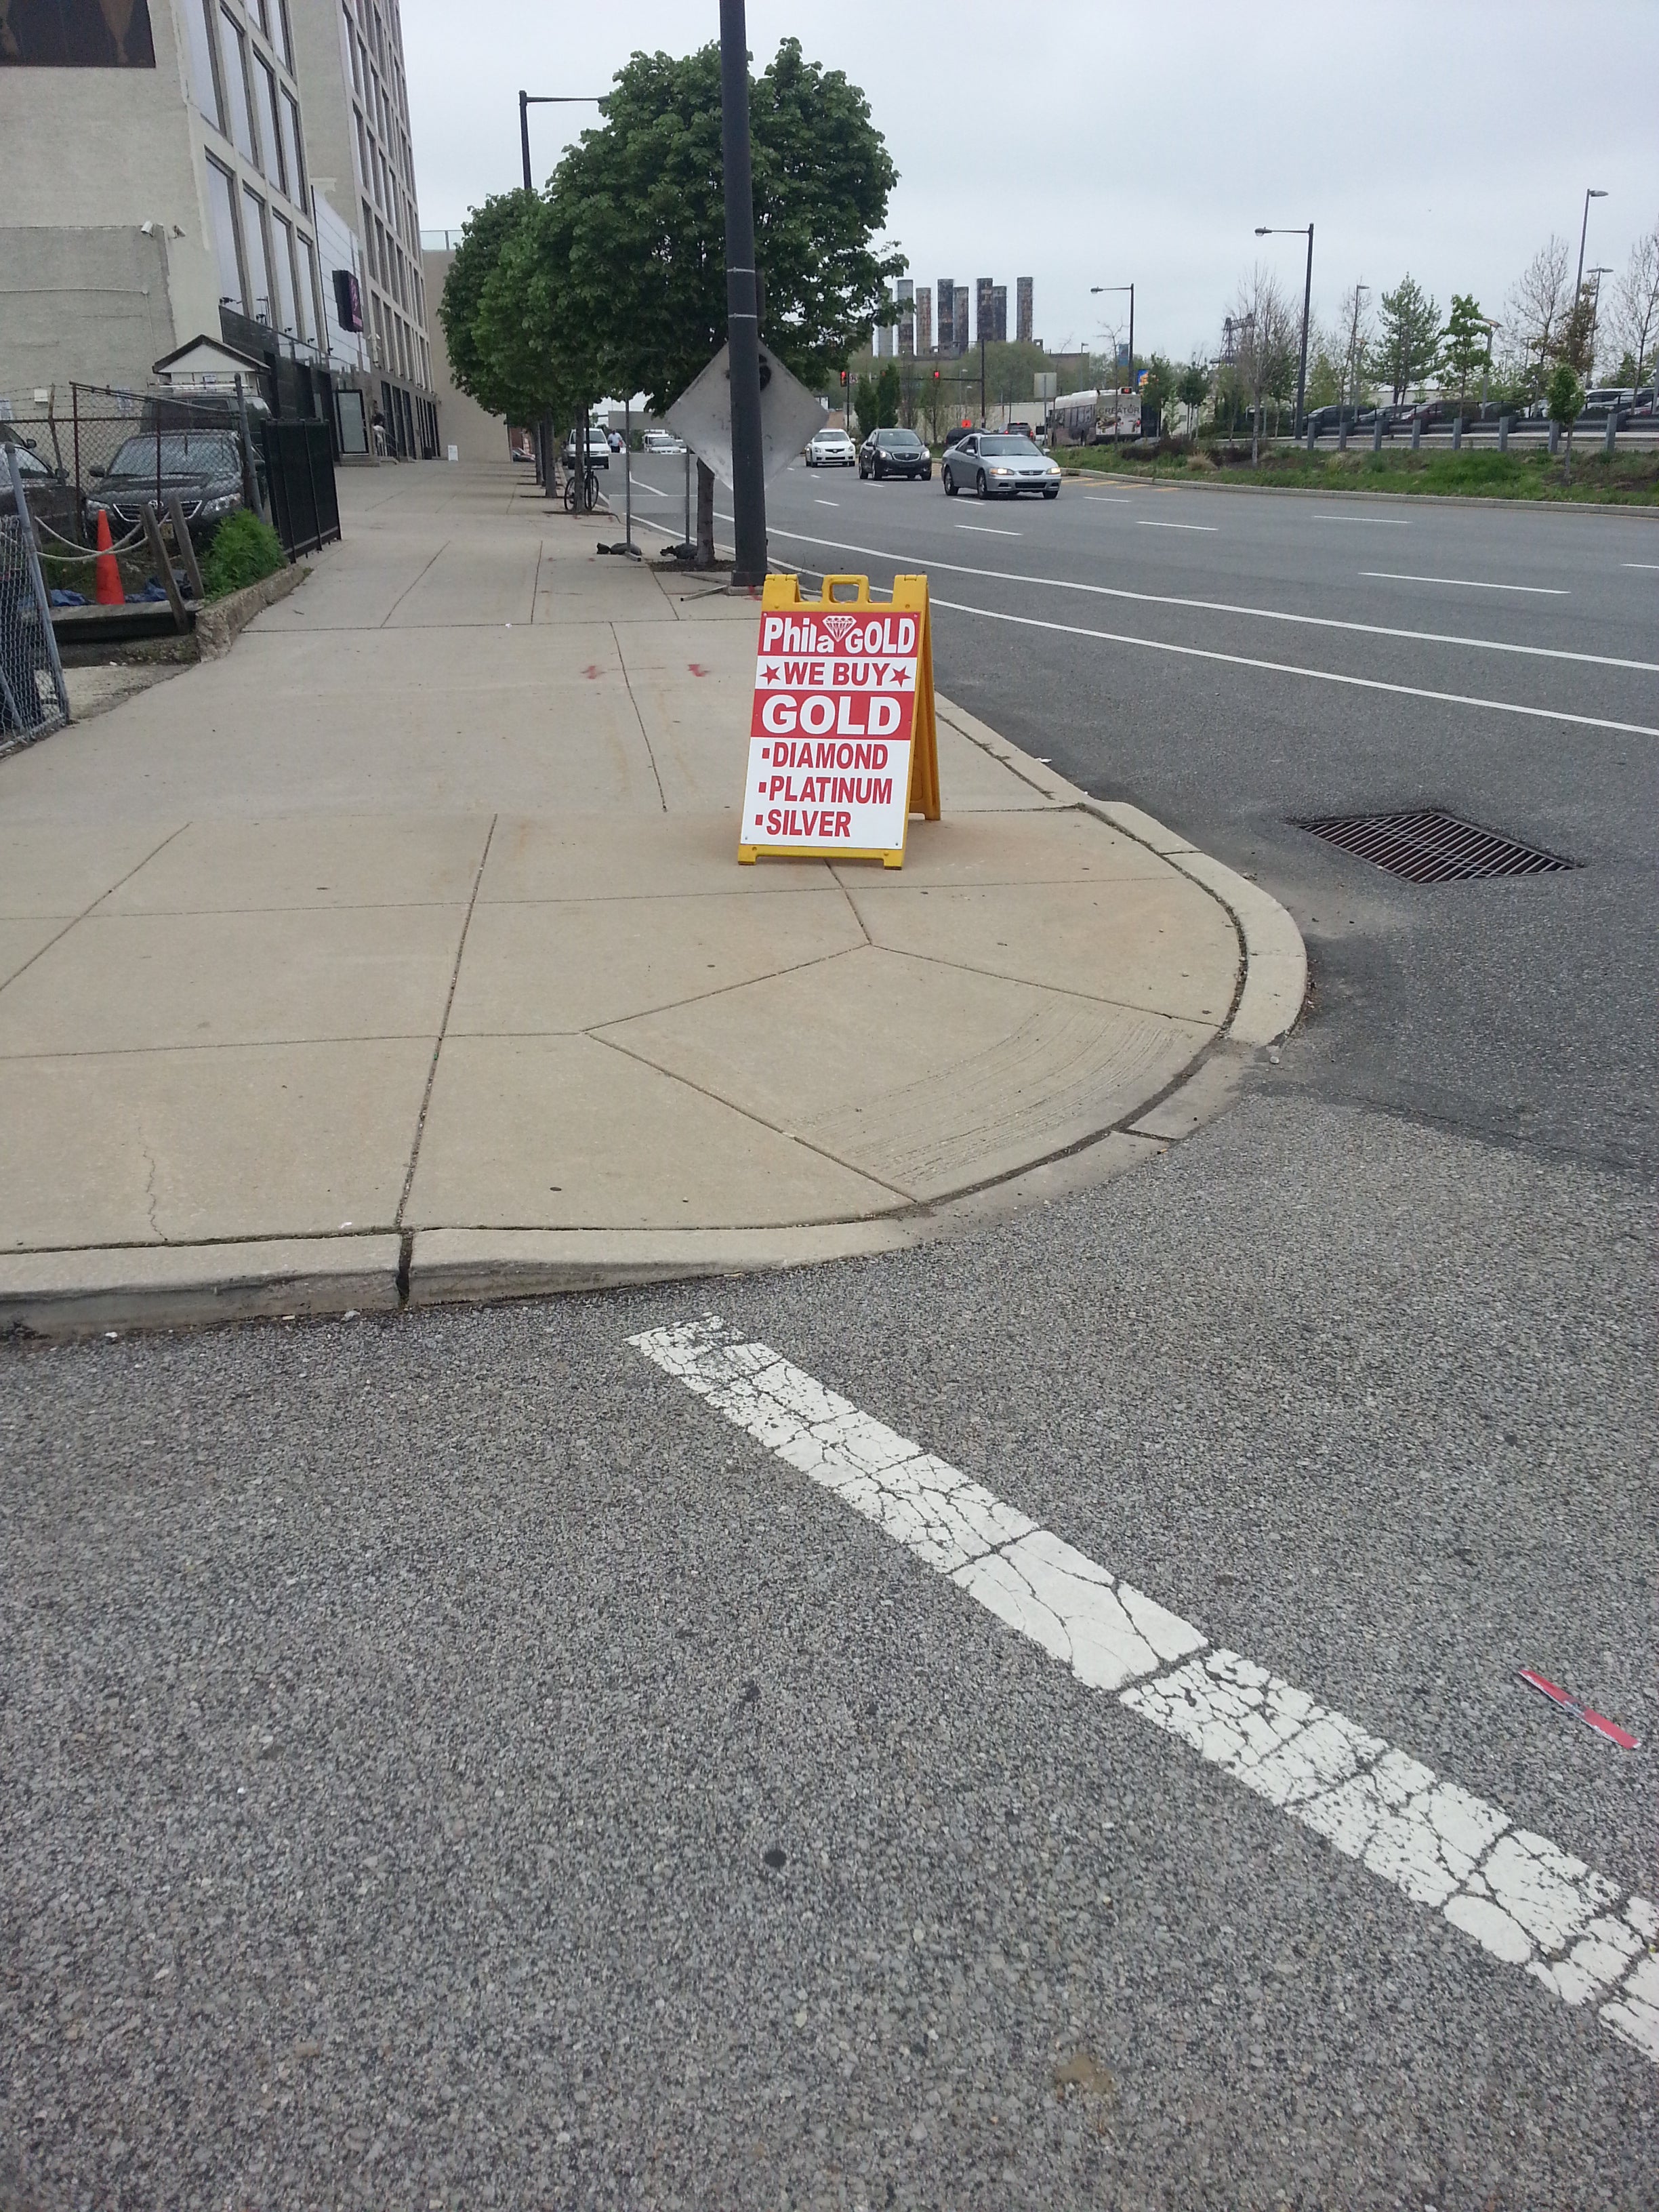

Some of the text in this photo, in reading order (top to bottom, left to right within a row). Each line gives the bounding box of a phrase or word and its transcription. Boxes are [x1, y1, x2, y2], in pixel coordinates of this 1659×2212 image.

[762, 617, 916, 654] Phila GOLD
[783, 661, 890, 686] WE BUY
[762, 694, 901, 735] GOLD
[773, 742, 888, 770] DIAMOND
[769, 775, 893, 804] PLATINUM
[766, 809, 852, 838] SILVER
